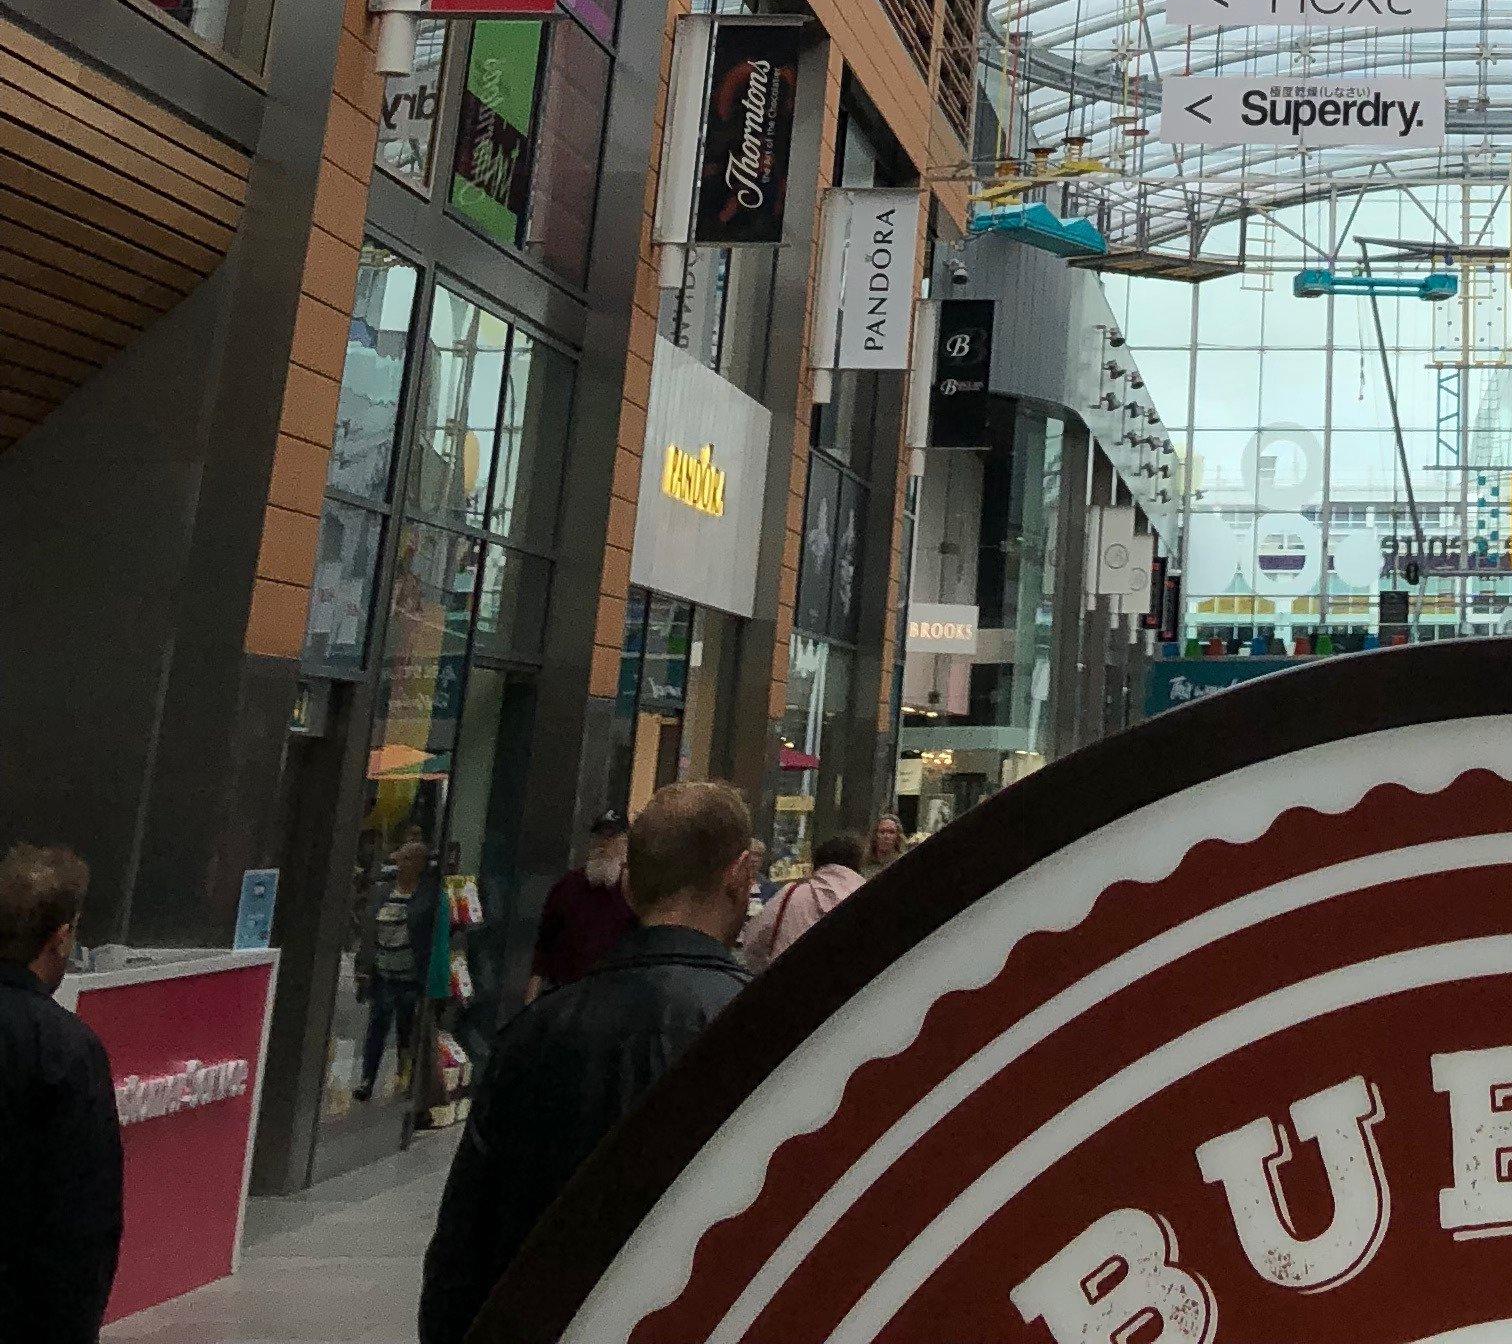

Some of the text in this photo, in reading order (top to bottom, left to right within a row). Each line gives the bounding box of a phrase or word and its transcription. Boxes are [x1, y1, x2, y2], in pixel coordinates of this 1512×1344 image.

[725, 60, 770, 208] Thorntons
[1241, 89, 1424, 137] Superdry.
[864, 208, 896, 351] PANDORA
